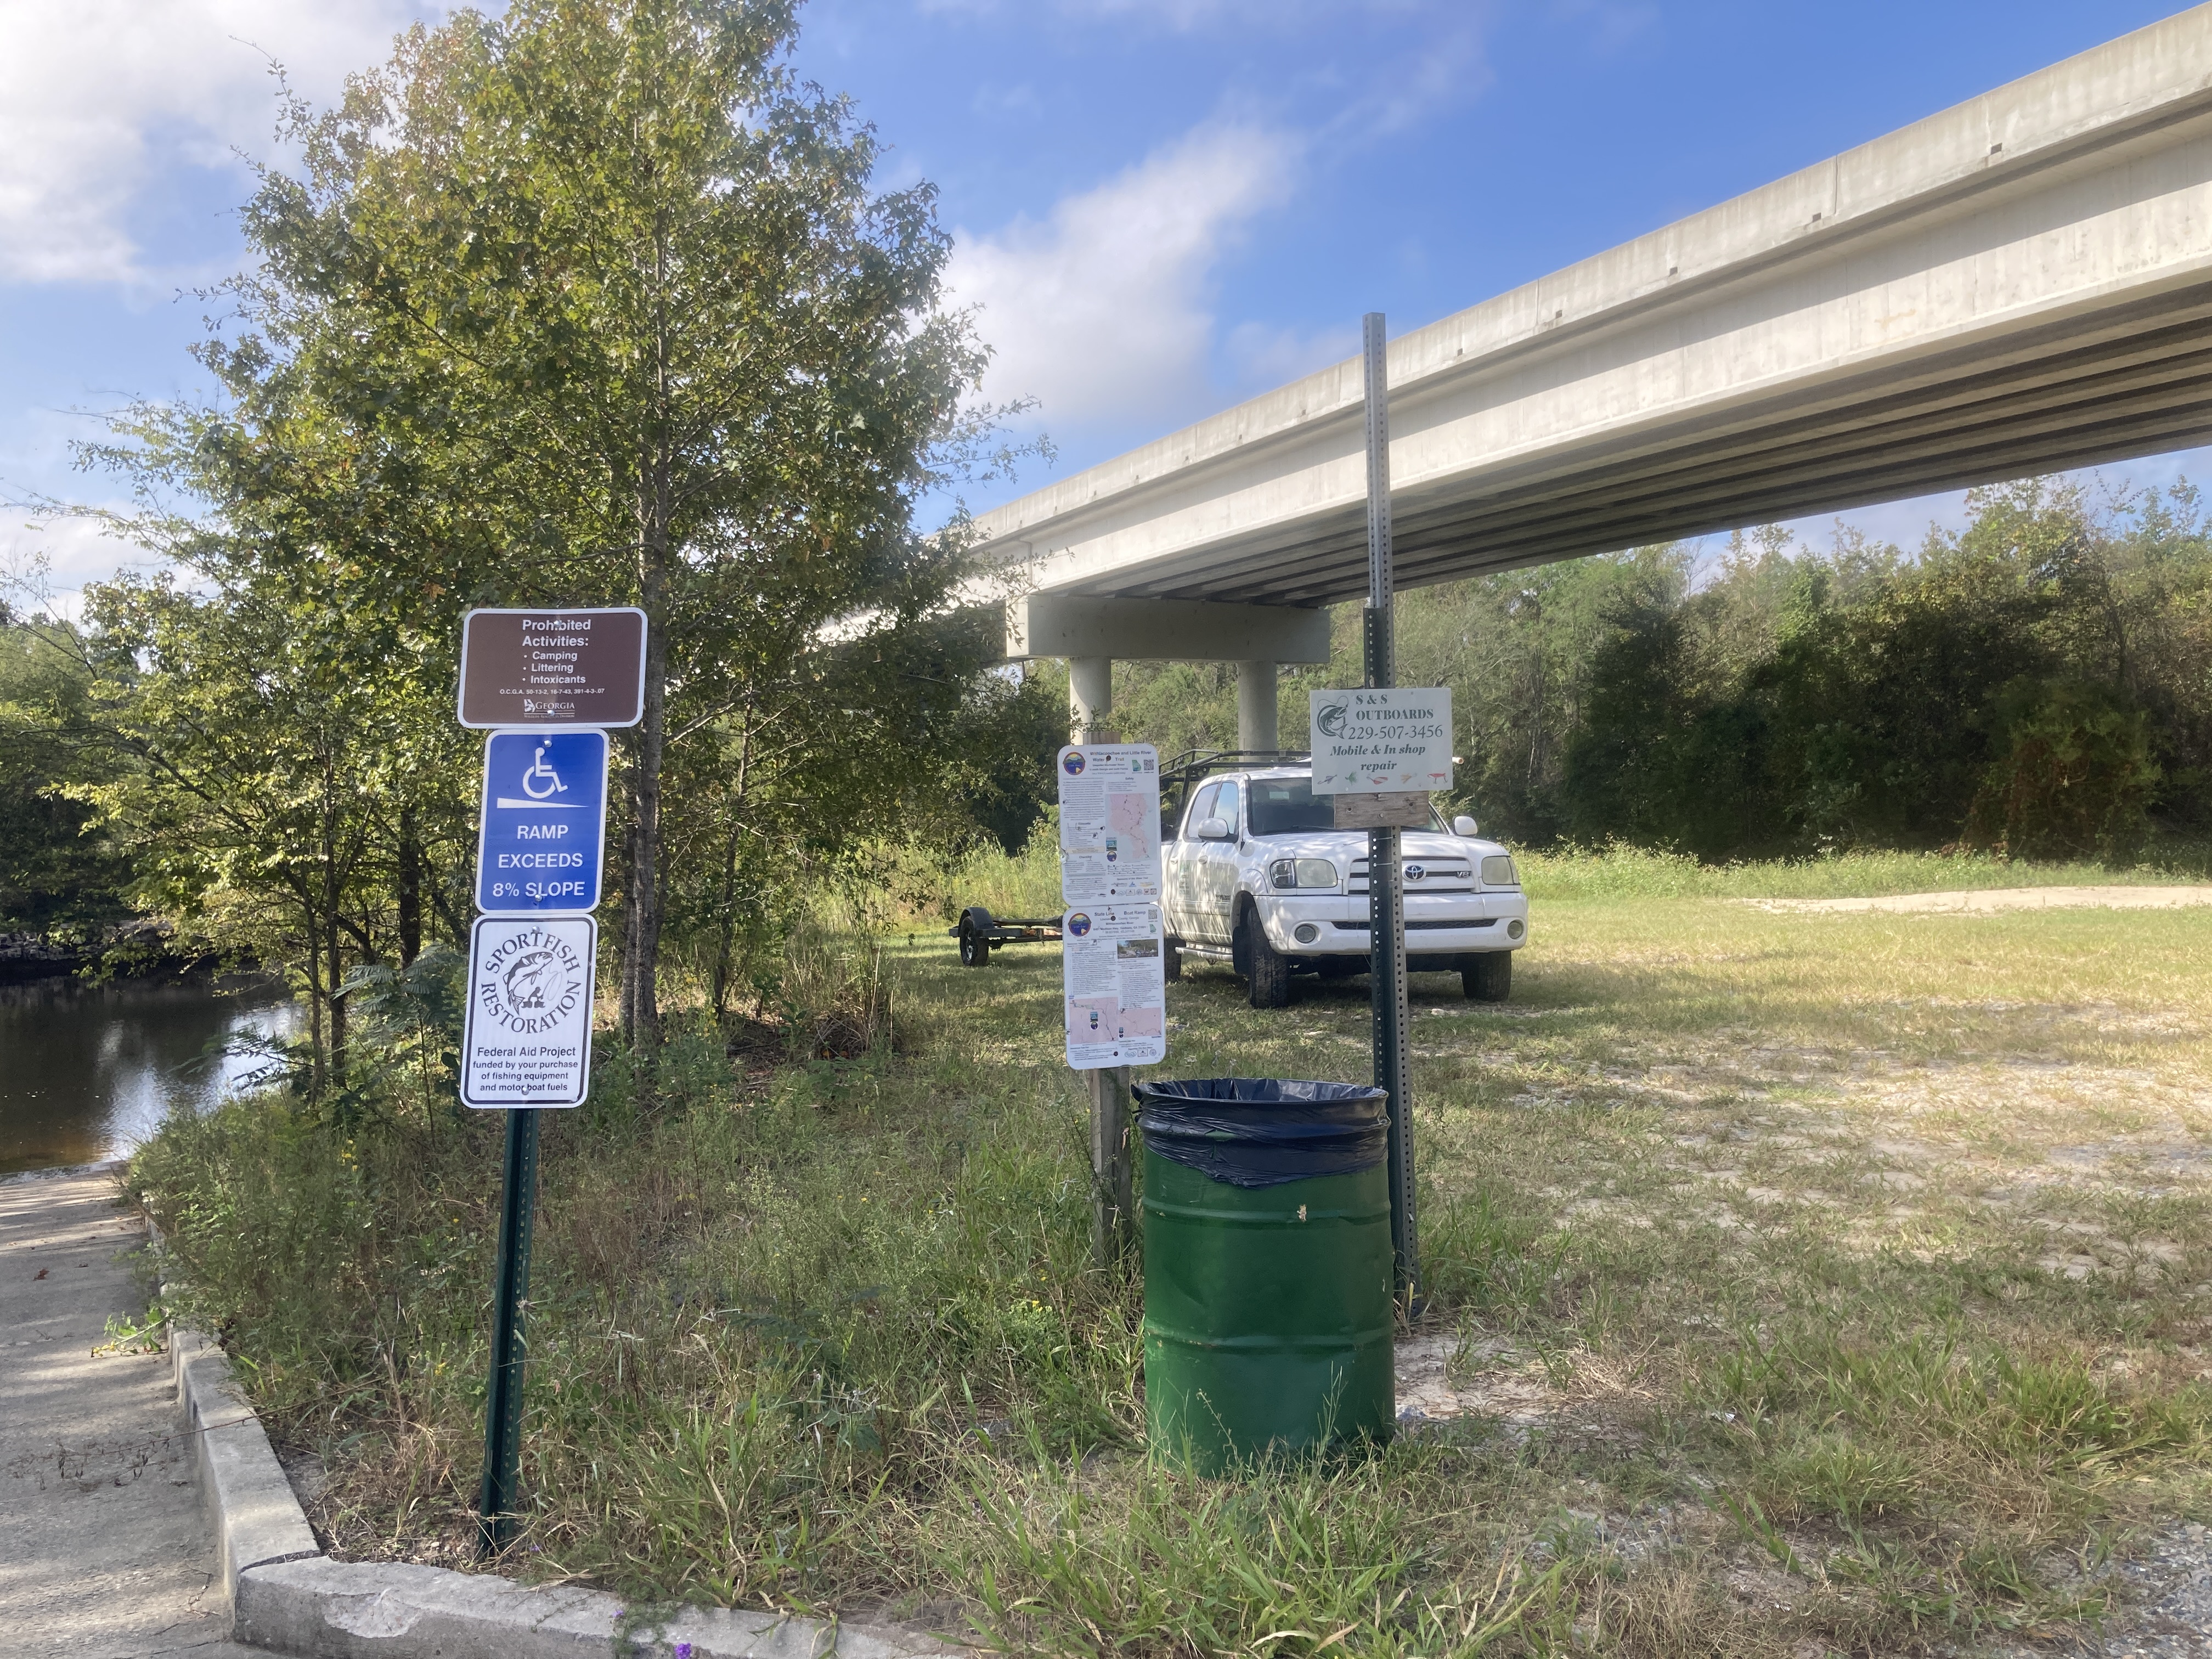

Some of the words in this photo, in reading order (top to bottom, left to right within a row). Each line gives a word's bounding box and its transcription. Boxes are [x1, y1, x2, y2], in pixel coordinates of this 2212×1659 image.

[522, 635, 589, 646] Activities:
[532, 651, 578, 662] Camping
[531, 663, 574, 673] Littering
[531, 675, 586, 684] Intoxicants
[1356, 695, 1363, 705] S
[1367, 695, 1377, 704] &
[1380, 695, 1387, 704] S
[1356, 709, 1434, 720] OUTBOARDS
[1348, 725, 1443, 740] 229-507-3456
[1330, 746, 1368, 757] Mobile
[1371, 745, 1381, 755] &
[1384, 744, 1396, 754] In
[1398, 744, 1426, 755] shop
[1361, 761, 1397, 772] repair
[517, 825, 569, 839] RAMP
[498, 853, 583, 868] EXCEEDS
[492, 882, 520, 897] 8%
[525, 882, 585, 897] SLOPE
[486, 933, 580, 974] SPORTFISH
[481, 980, 582, 1034] RESTORATION
[477, 1047, 516, 1056] Federal
[520, 1047, 537, 1056] Aid
[540, 1047, 576, 1058] Project
[506, 1061, 516, 1070] by
[540, 1061, 578, 1069] purchase
[493, 1072, 521, 1081] fishing
[524, 1072, 568, 1081] equipment
